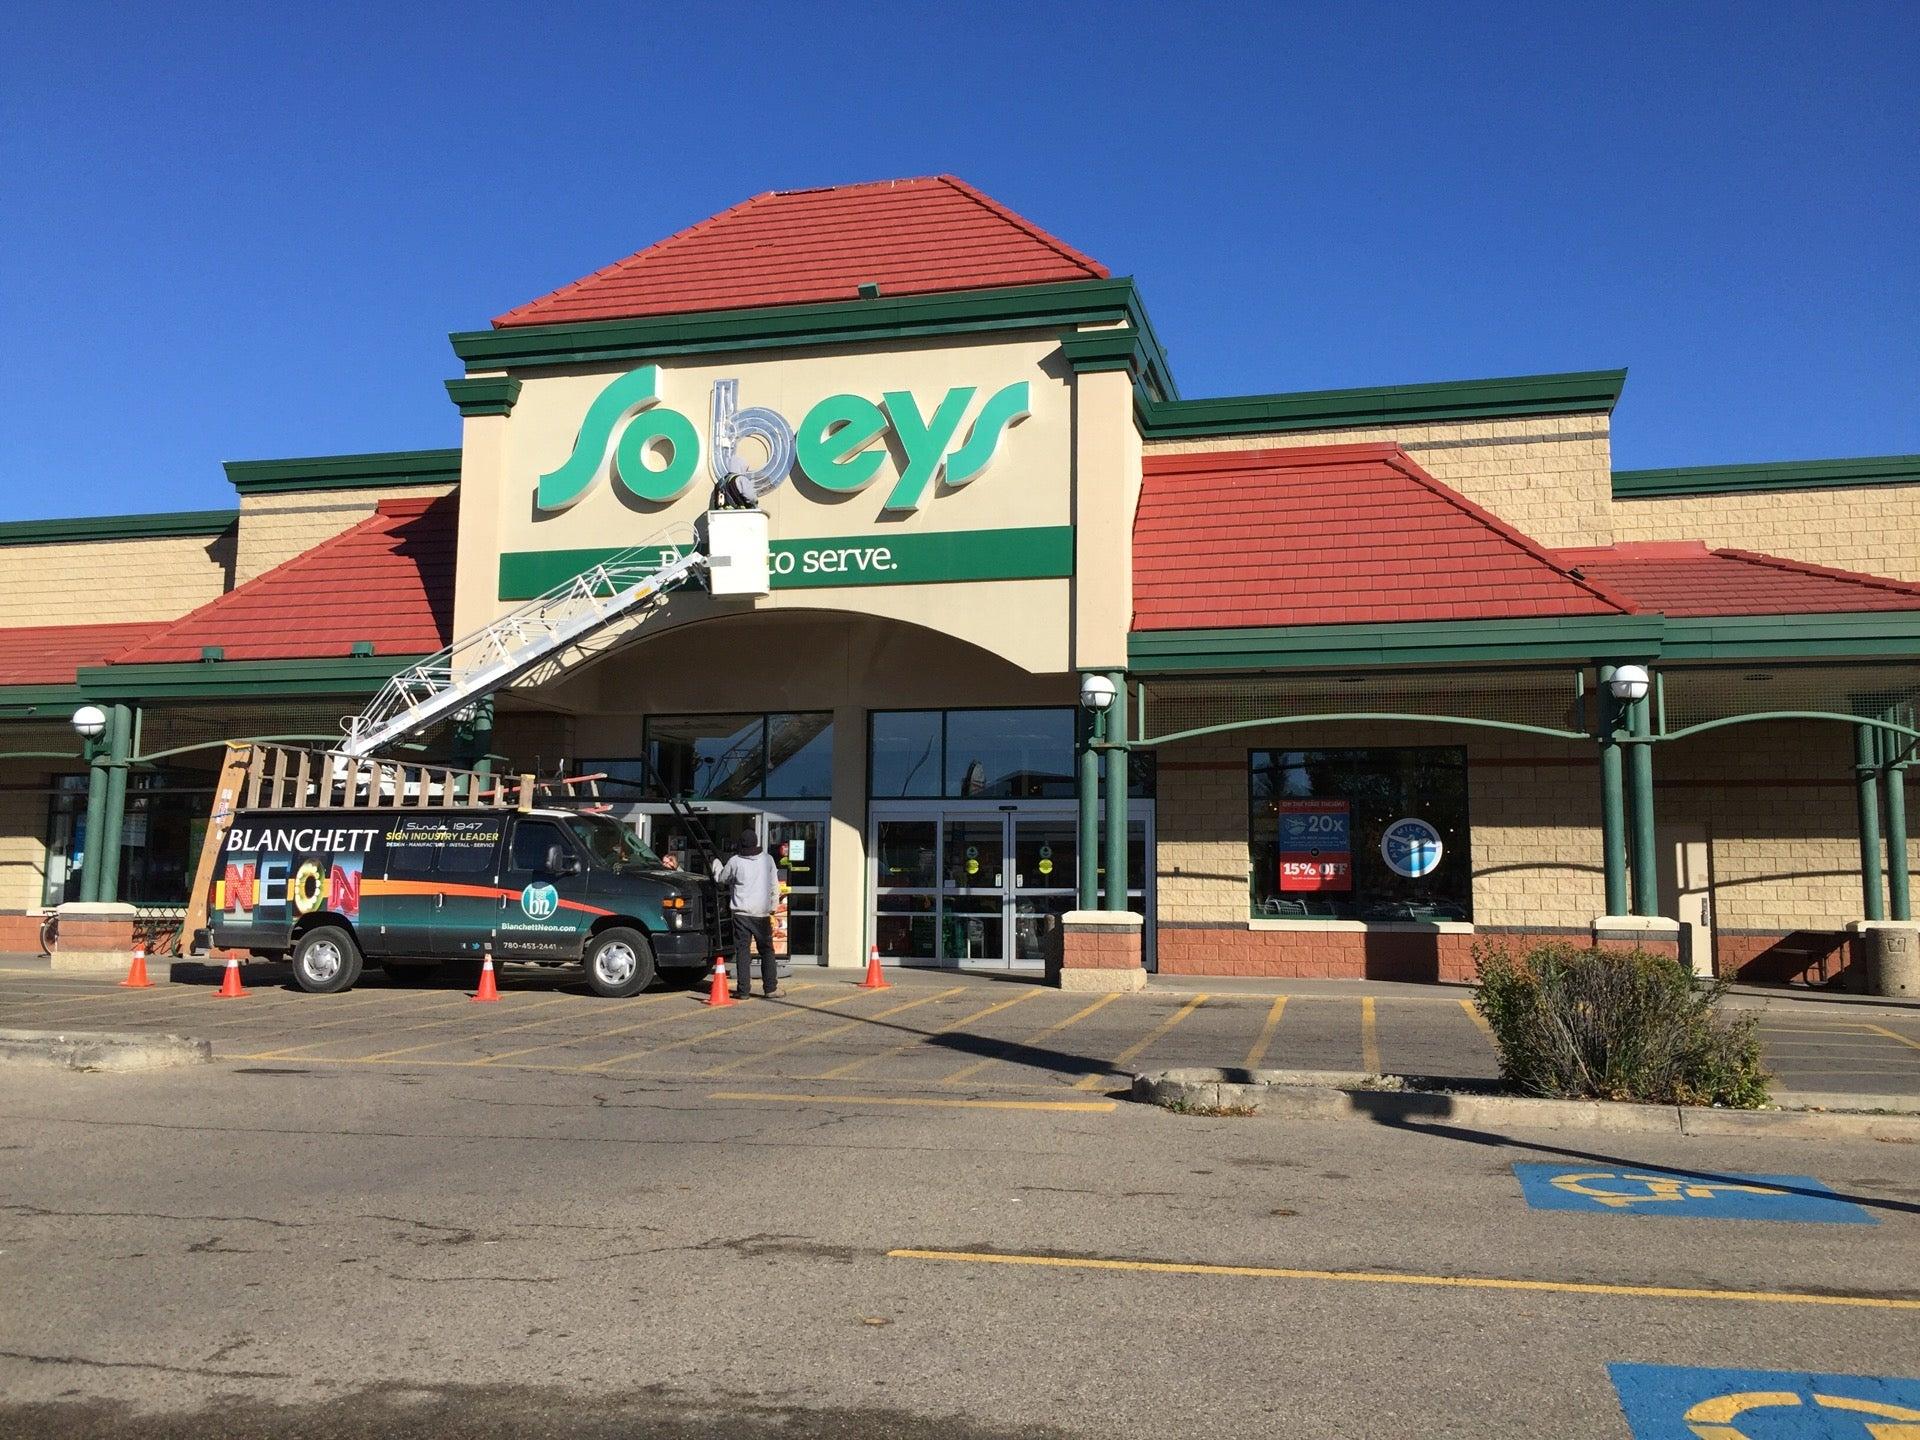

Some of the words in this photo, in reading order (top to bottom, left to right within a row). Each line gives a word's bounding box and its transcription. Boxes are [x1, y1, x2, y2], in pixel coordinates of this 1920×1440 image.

[538, 364, 1031, 512] Sobeys
[803, 547, 898, 573] serve.
[406, 822, 449, 830] Since
[453, 822, 483, 830] 1947
[1309, 815, 1343, 832] 20x
[226, 829, 379, 851] BLANCHETT
[386, 832, 410, 840] SIGN
[410, 832, 458, 840] INDUSTRY
[460, 832, 499, 840] LEADER
[1283, 863, 1317, 875] 15%
[1319, 863, 1348, 875] OFF
[223, 859, 363, 917] NEON
[501, 922, 577, 932] BlanchettNeon.com
[503, 942, 557, 950] 780-453-2441
